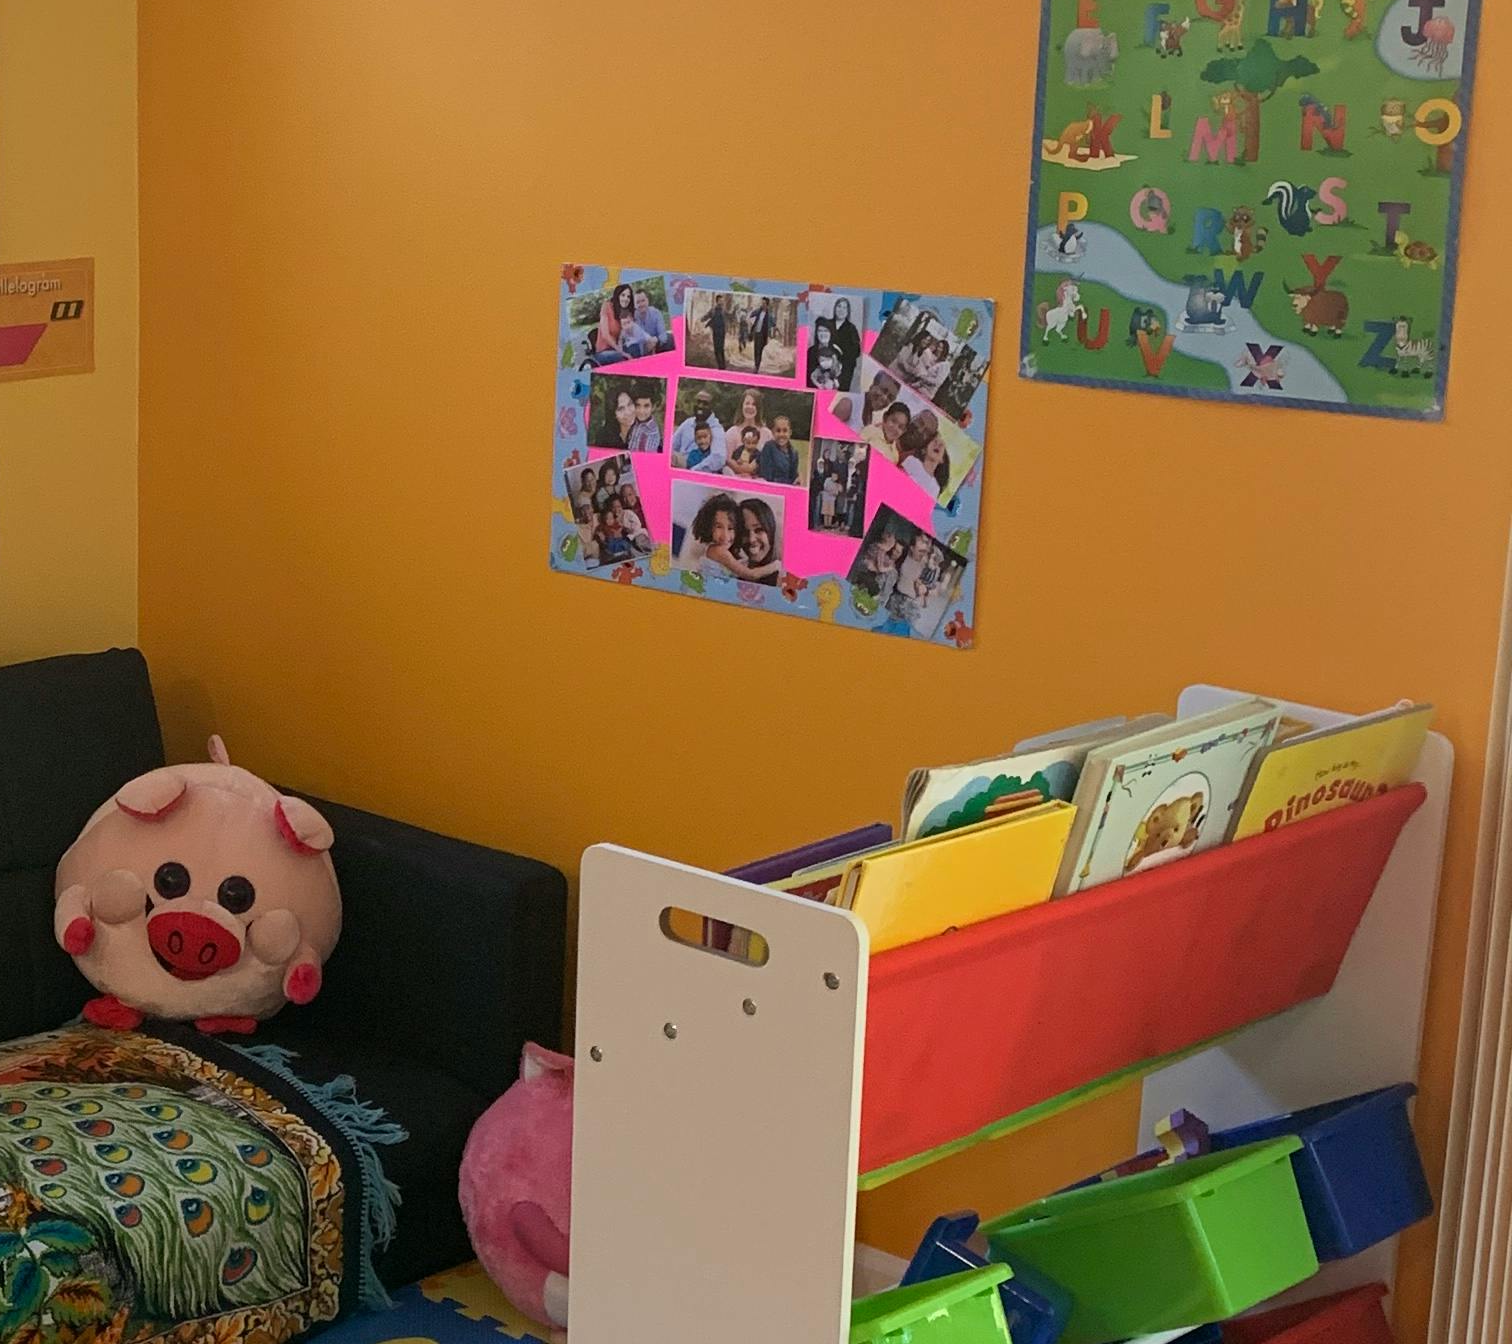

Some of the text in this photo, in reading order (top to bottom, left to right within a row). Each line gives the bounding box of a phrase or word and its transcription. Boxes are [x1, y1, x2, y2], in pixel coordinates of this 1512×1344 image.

[1143, 2, 1171, 49] F
[1087, 94, 1462, 163] K L M N O
[1057, 177, 1412, 256] P Q R S T
[1214, 253, 1343, 308] W Y
[1076, 308, 1398, 391] U V X Z
